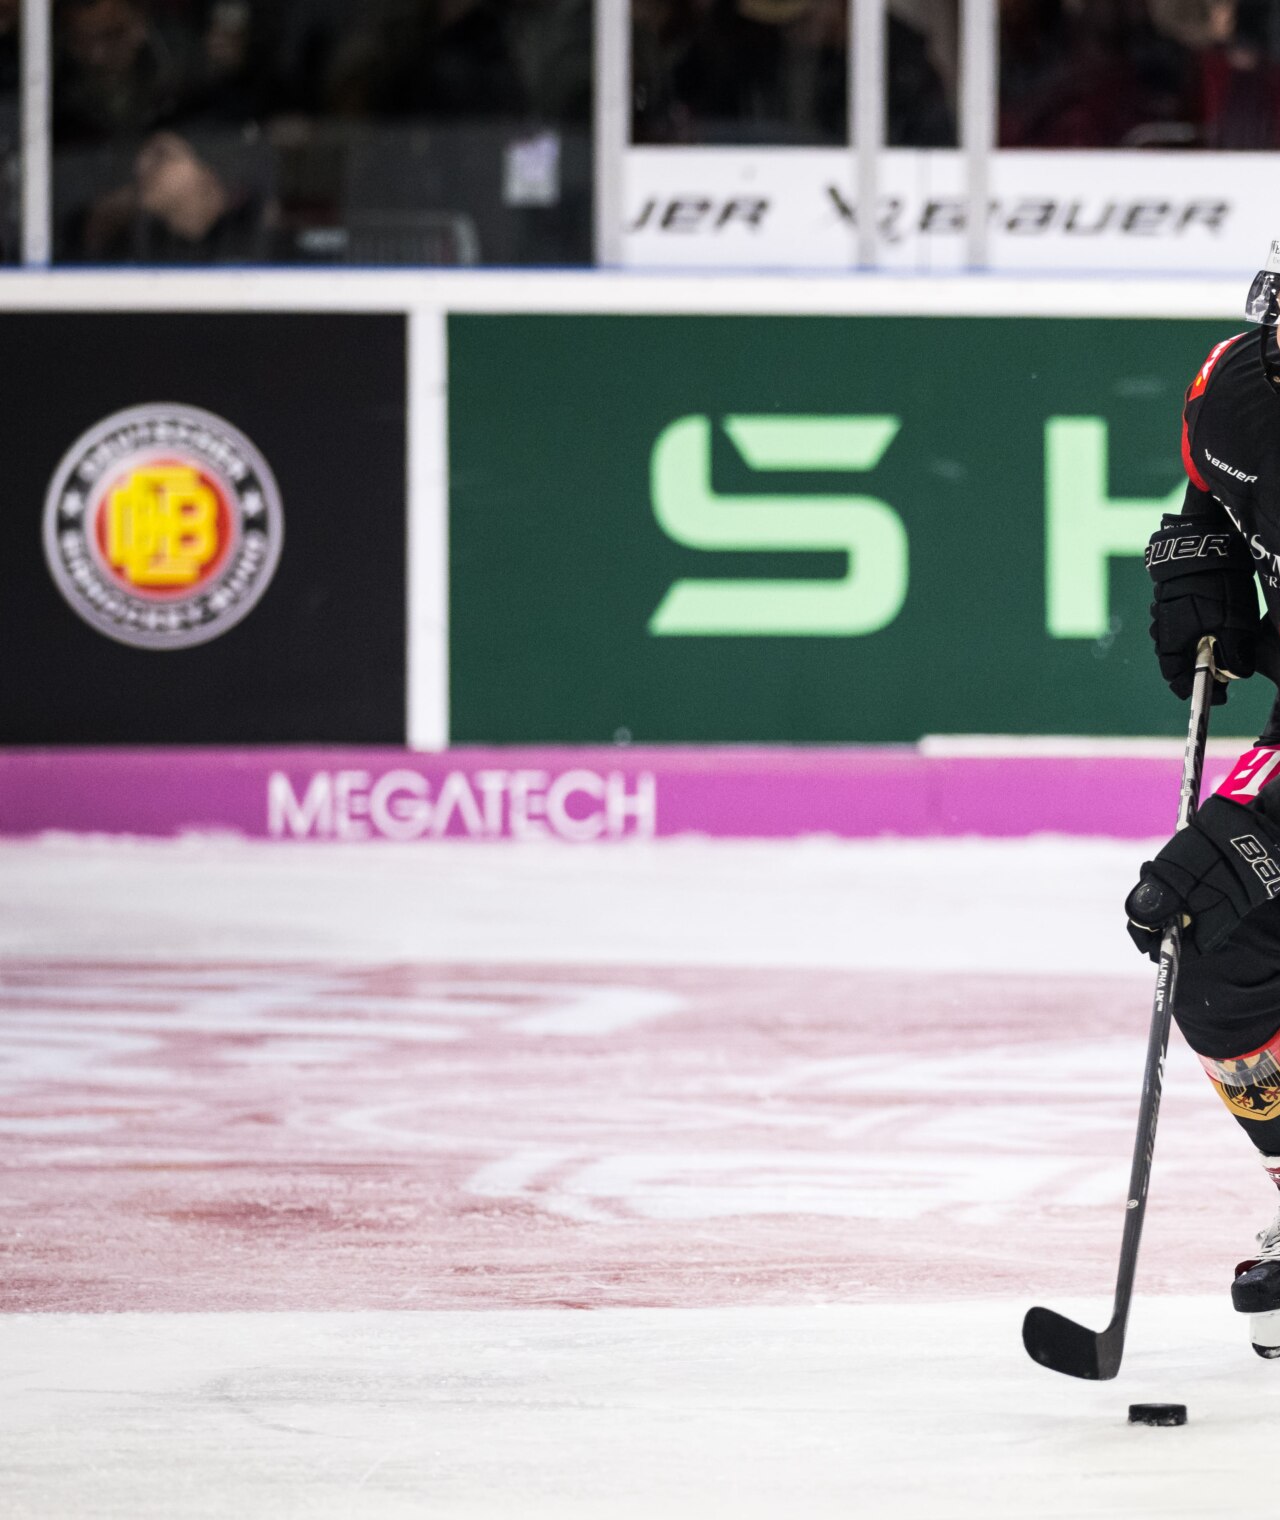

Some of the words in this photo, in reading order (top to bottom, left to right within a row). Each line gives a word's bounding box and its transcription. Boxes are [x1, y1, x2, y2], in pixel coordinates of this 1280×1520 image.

[1210, 457, 1259, 485] BAUER
[267, 768, 659, 840] MEGATECH
[1157, 957, 1169, 988] ALPHA
